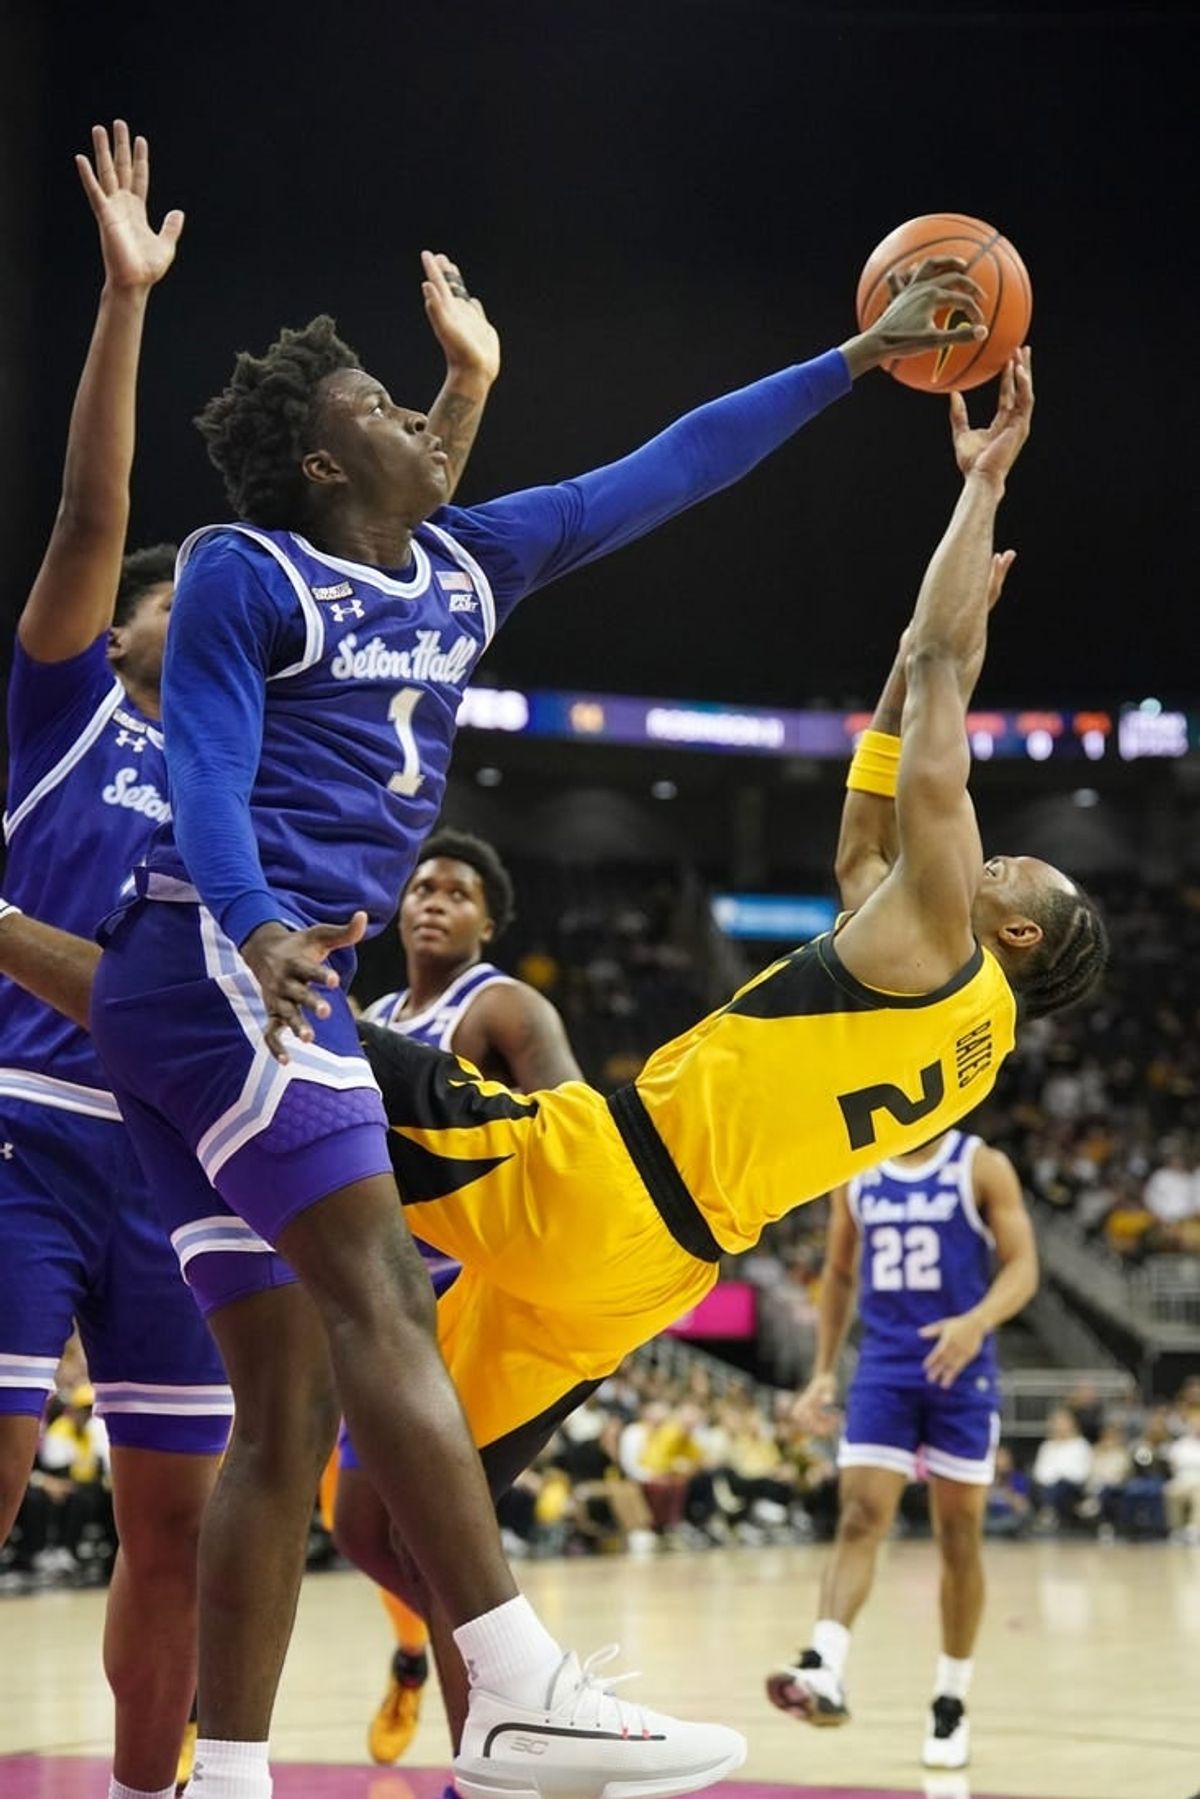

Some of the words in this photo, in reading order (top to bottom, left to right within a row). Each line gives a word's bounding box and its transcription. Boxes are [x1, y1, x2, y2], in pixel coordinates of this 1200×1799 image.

[332, 634, 412, 679] Seton
[411, 630, 477, 684] Hall
[387, 687, 426, 797] 1
[956, 1020, 991, 1088] BATES
[836, 1059, 944, 1151] 2
[870, 1225, 942, 1292] 22
